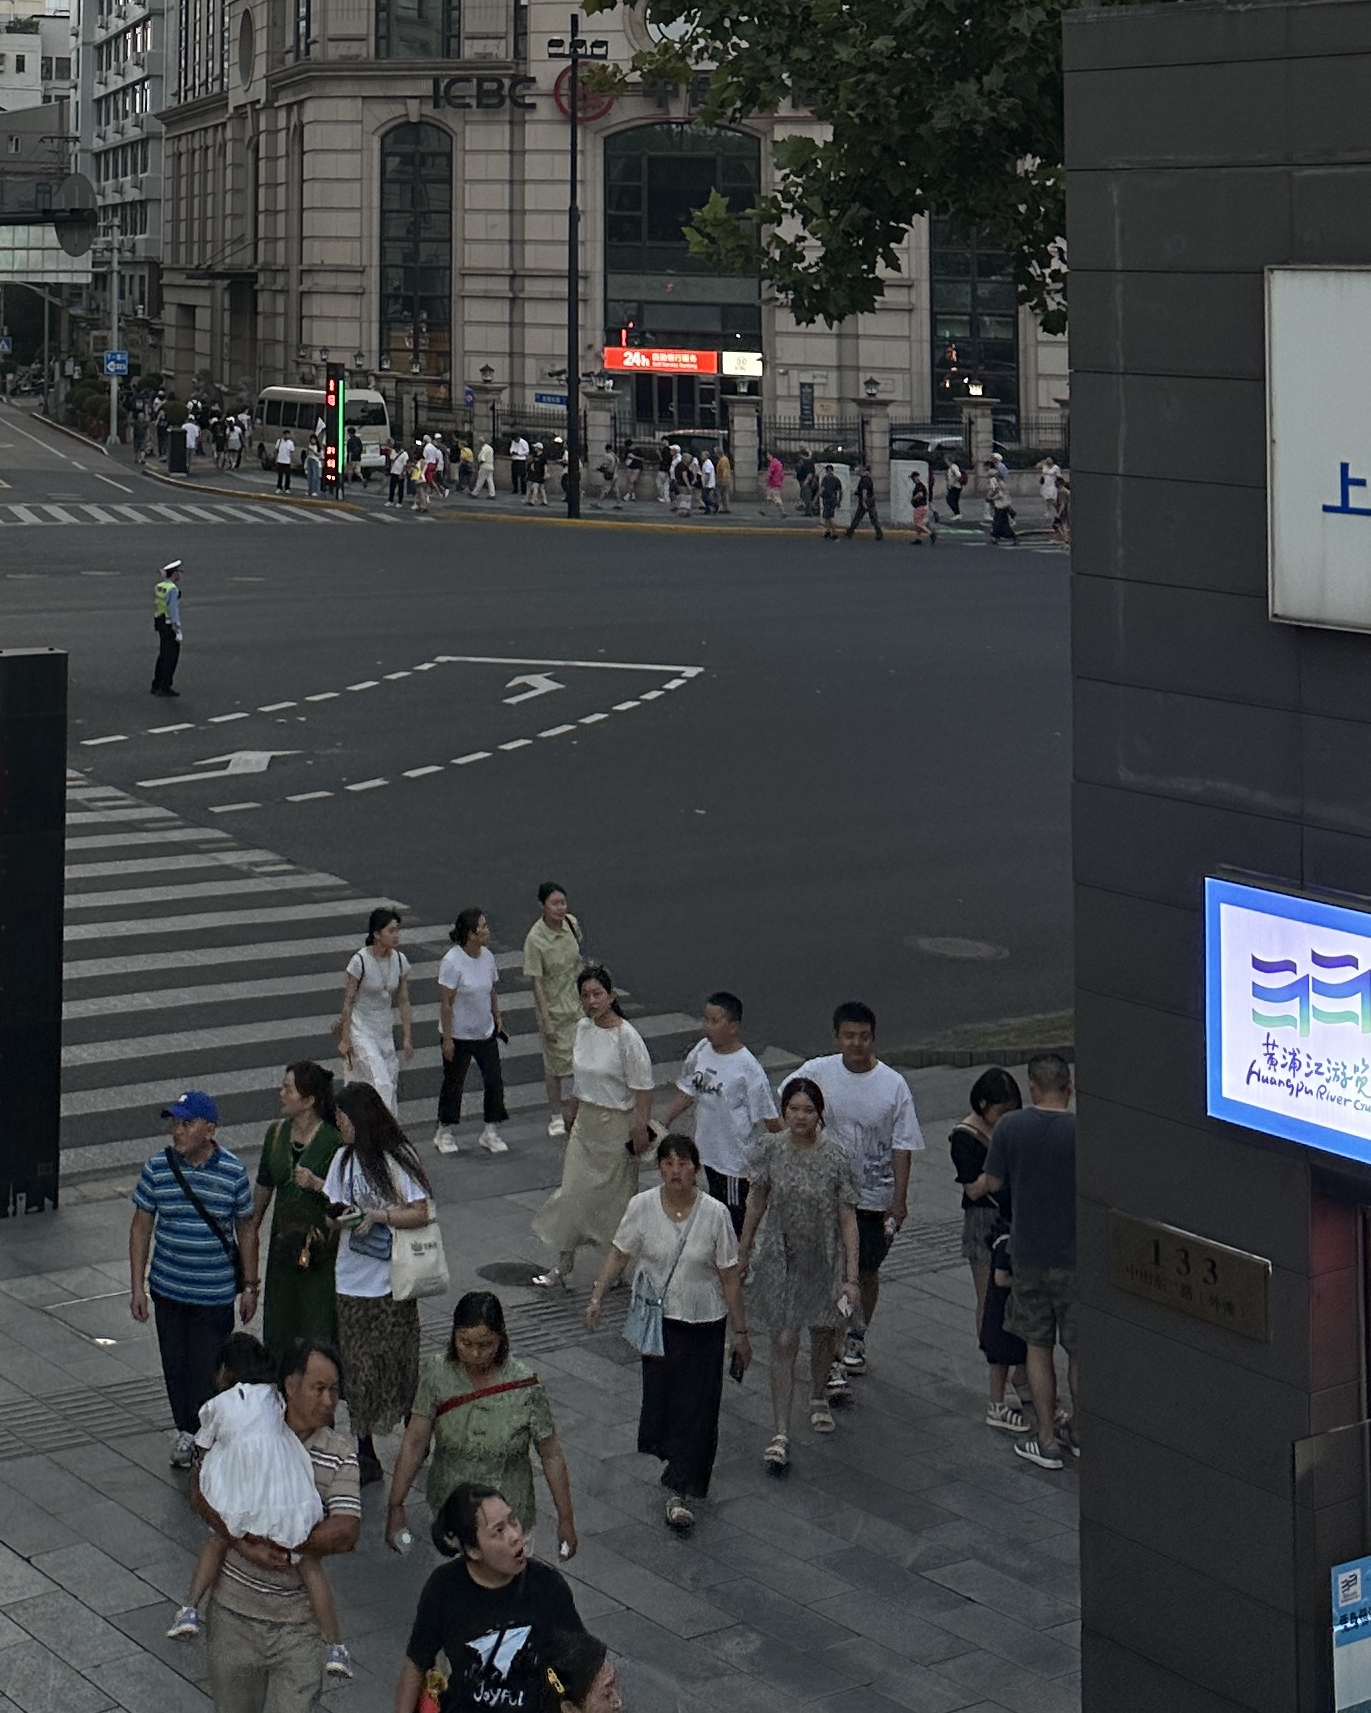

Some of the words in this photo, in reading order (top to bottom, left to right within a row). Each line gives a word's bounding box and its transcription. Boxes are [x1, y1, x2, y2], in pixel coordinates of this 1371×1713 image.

[433, 76, 537, 109] ICBC
[623, 351, 650, 367] 24h
[1322, 461, 1371, 517] 上
[1246, 1059, 1314, 1098] Huangpu
[1316, 1085, 1353, 1106] River
[1151, 1239, 1219, 1286] 133
